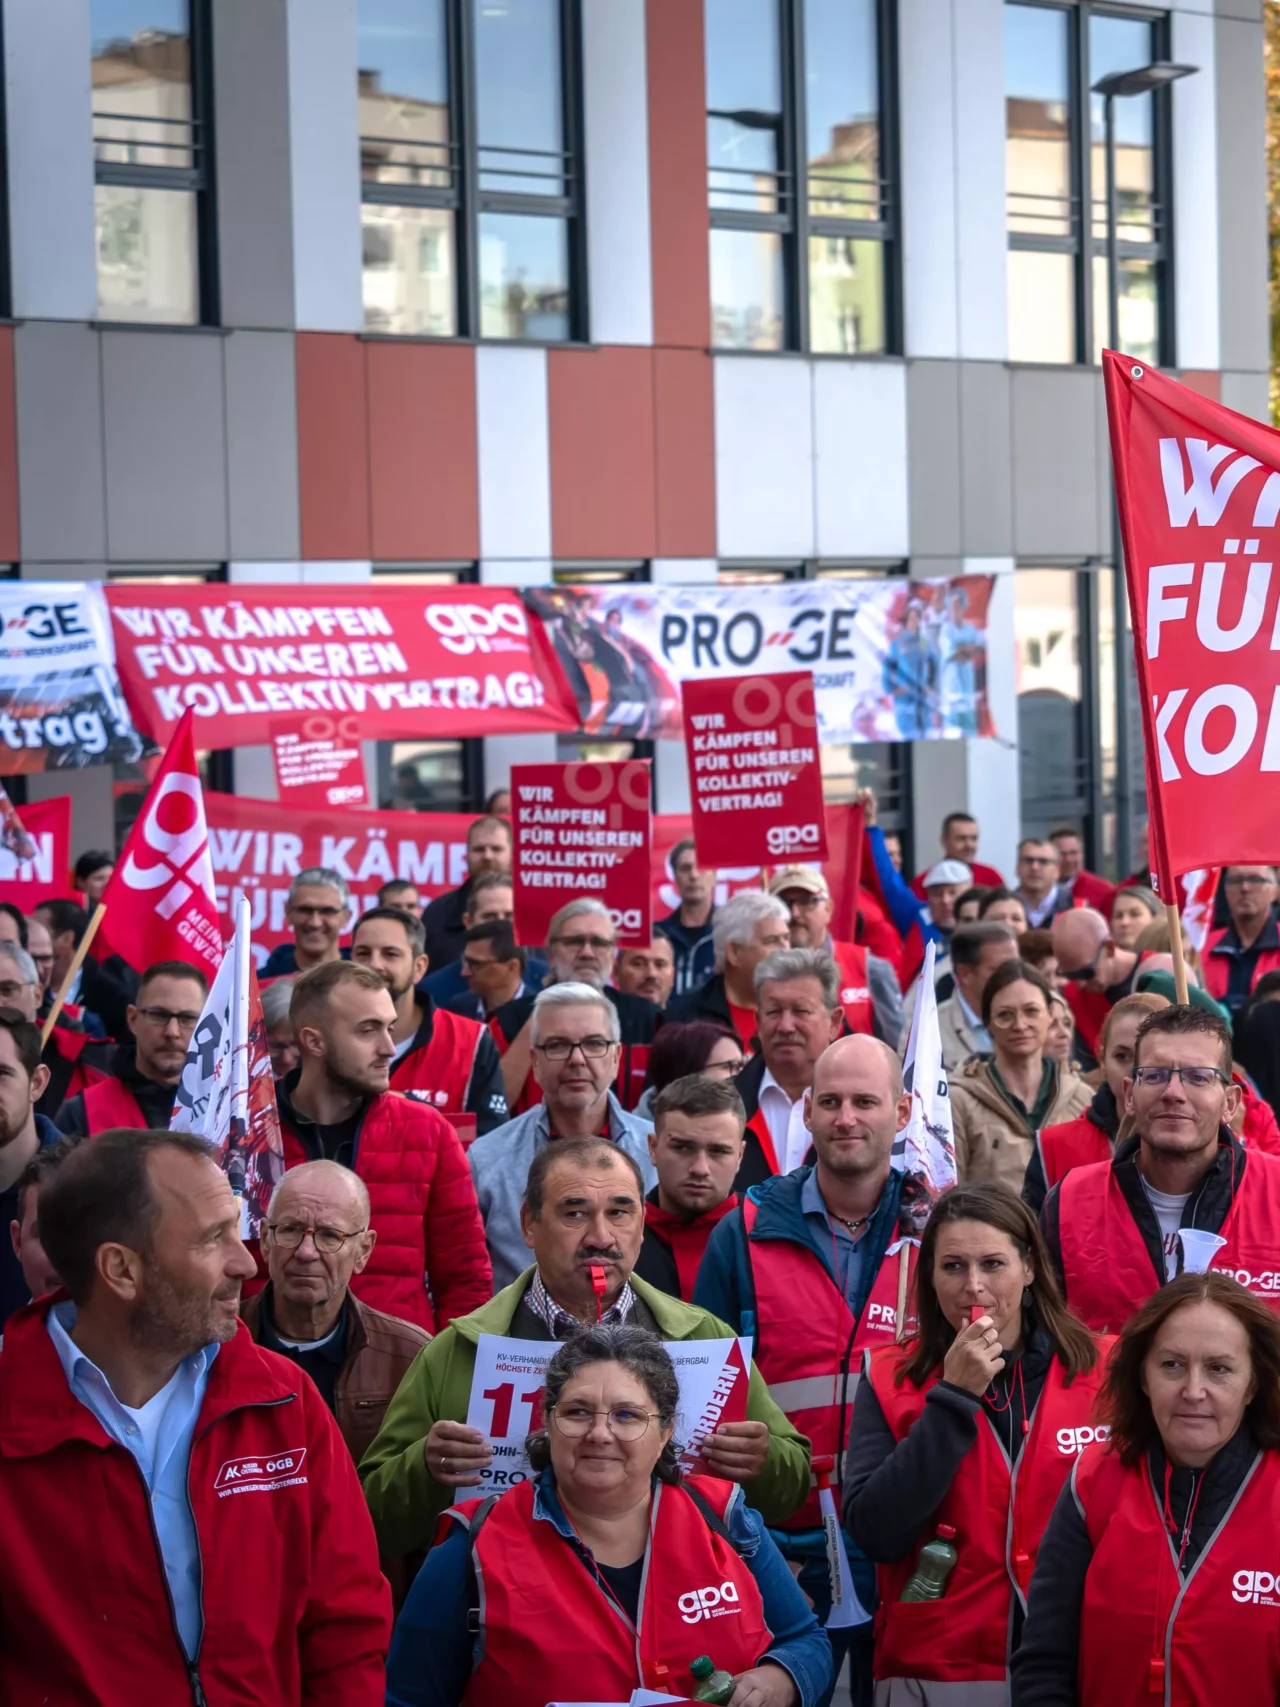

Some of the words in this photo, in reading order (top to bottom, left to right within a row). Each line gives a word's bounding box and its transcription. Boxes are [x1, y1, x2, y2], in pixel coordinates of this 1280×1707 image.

[112, 606, 202, 638] WIR
[199, 600, 393, 640] KÄMPFEN
[424, 603, 530, 656] gpa
[133, 636, 226, 679] FÜR
[221, 641, 409, 678] UNSEREN
[691, 713, 726, 731] WIR
[693, 729, 777, 751] KÄMPFEN
[695, 752, 730, 772] FÜR
[732, 747, 814, 768] UNSEREN
[697, 770, 797, 793] KOLLEKTIV-
[518, 786, 553, 803] WIR
[699, 792, 783, 813] VERTRAG!
[519, 805, 606, 825] KÄMPFEN
[519, 825, 555, 845] FÜR
[559, 829, 643, 847] UNSEREN
[766, 823, 819, 855] gpa
[519, 849, 623, 868] KOLLEKTIV-
[519, 870, 607, 889] VERTRAG!
[496, 1363, 532, 1374] HÖCHSTE
[676, 1357, 709, 1366] BERGBAU
[1056, 1425, 1111, 1455] gpa
[224, 1465, 241, 1481] AK
[266, 1457, 294, 1472] ÖGB
[218, 1488, 232, 1498] WIR
[677, 1581, 739, 1624] gpa
